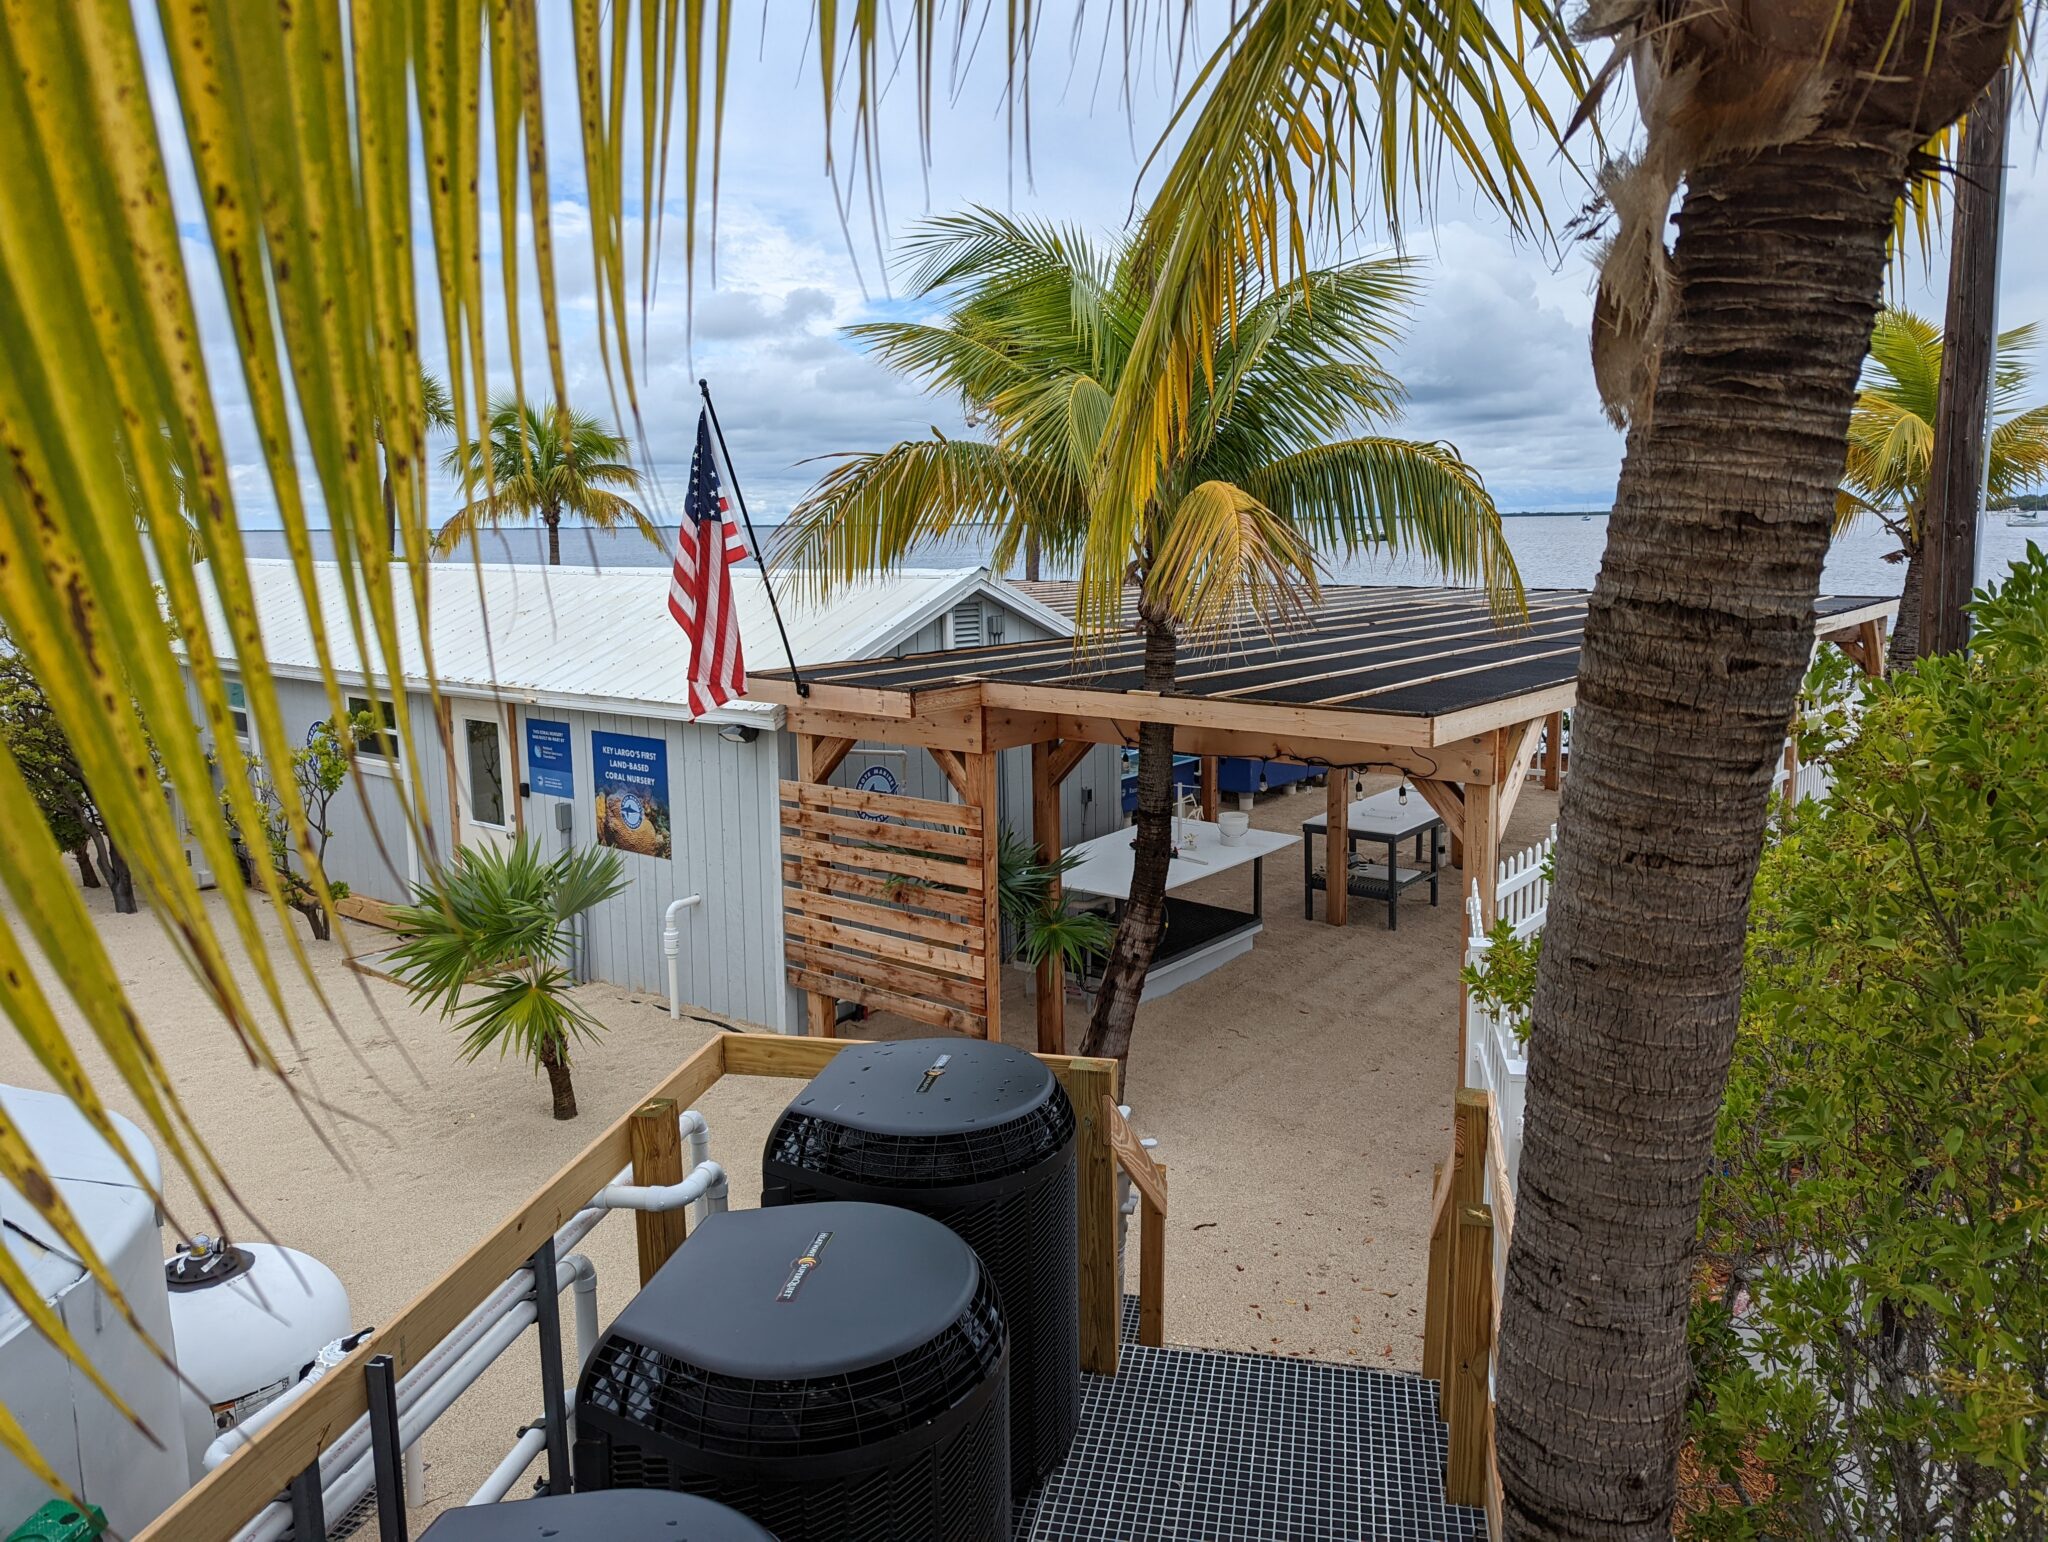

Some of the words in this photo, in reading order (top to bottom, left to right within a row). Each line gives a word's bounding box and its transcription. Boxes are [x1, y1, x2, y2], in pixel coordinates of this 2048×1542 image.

[602, 746, 614, 754] KEY
[614, 747, 640, 758] LARGO'S
[641, 751, 657, 761] FIRST
[609, 759, 650, 773] LAND-BASED
[604, 771, 626, 781] CORAL
[626, 774, 655, 786] NURSERY
[858, 771, 871, 789] MOTE
[873, 768, 895, 786] MARINE
[783, 1263, 809, 1299] SUPERQUIET
